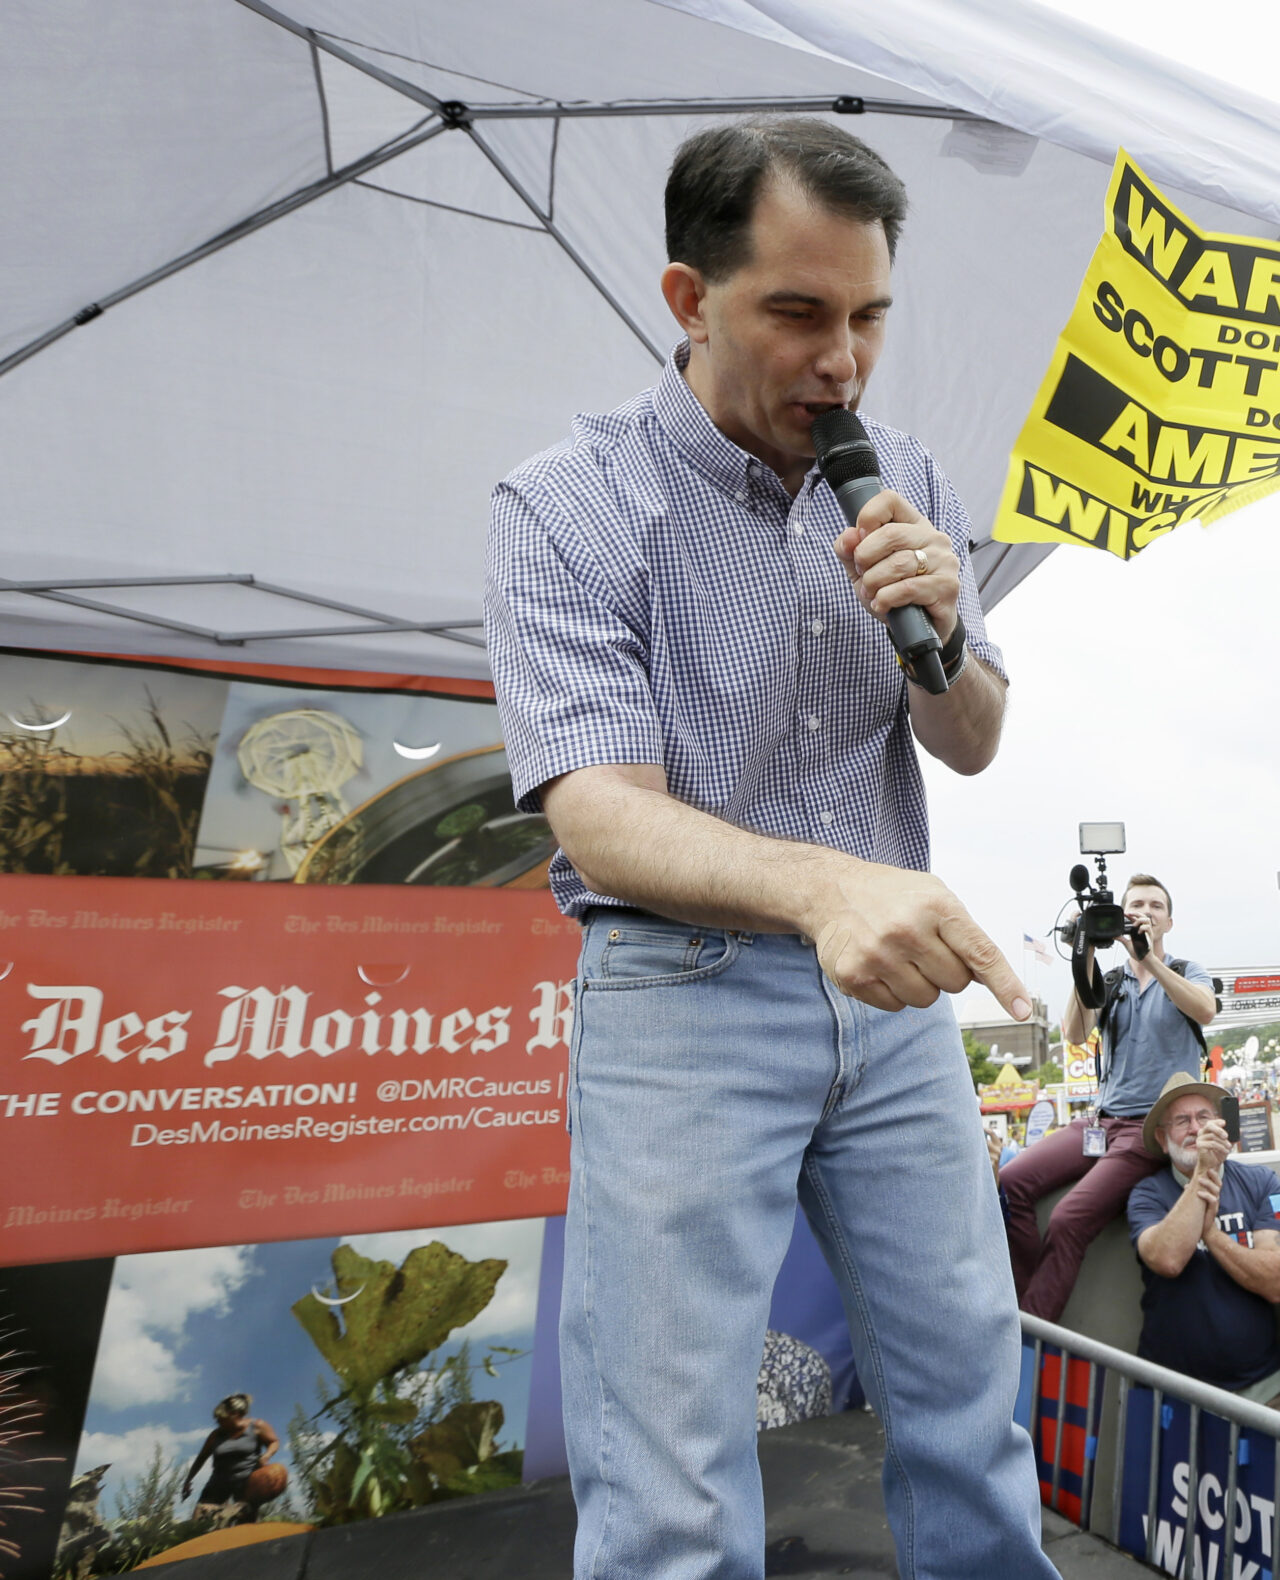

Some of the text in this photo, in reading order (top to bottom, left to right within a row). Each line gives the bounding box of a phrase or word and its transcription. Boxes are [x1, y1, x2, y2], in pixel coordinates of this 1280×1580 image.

[1093, 280, 1279, 397] SCOTT
[27, 909, 68, 928] Des
[70, 910, 154, 930] Moines
[156, 912, 243, 934] Register
[284, 915, 504, 936] The Des Moines Register
[530, 918, 562, 937] The
[1076, 930, 1086, 955] Canon
[20, 983, 193, 1066] Des
[204, 984, 512, 1068] Moines
[71, 1082, 357, 1115] CONVERSATION!
[376, 1076, 551, 1102] @DMRCaucus
[130, 1106, 560, 1147] DesMoinesRegister.com/Caucus
[238, 1177, 475, 1210] The Des Moines Register
[503, 1170, 537, 1190] The
[3, 1198, 193, 1229] Moines Register
